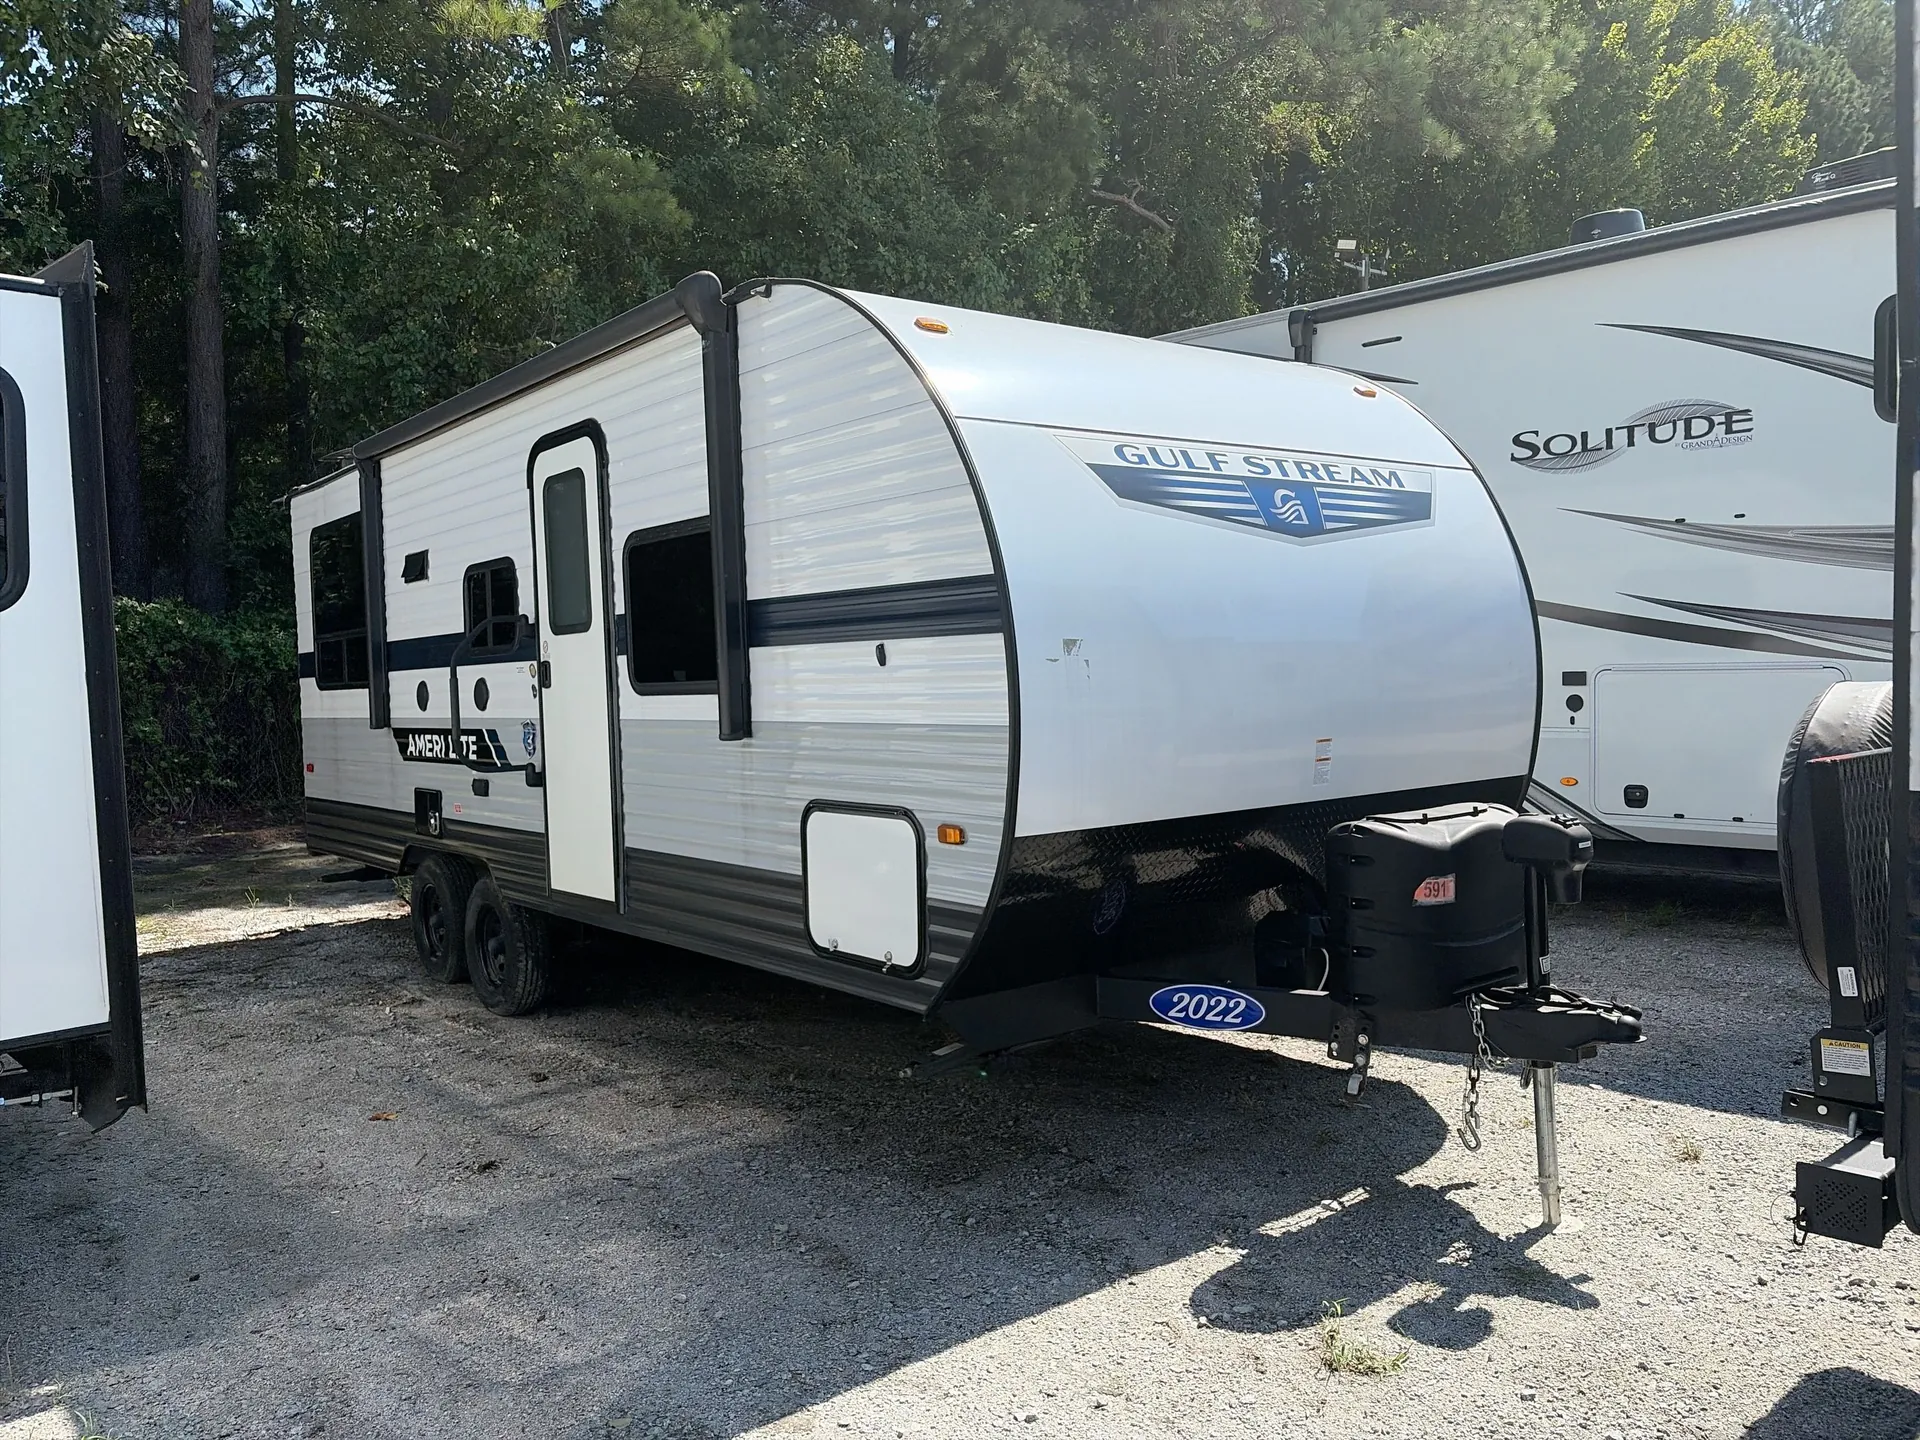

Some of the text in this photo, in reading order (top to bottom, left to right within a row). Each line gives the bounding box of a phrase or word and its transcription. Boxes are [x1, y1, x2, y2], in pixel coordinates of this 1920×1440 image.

[1510, 408, 1754, 462] SOLITUDE
[1721, 434, 1753, 445] DESIGN
[1113, 443, 1406, 489] GULF STREAM
[406, 733, 478, 760] AMERI LTE
[1423, 880, 1447, 899] 591
[1167, 992, 1247, 1024] 2022
